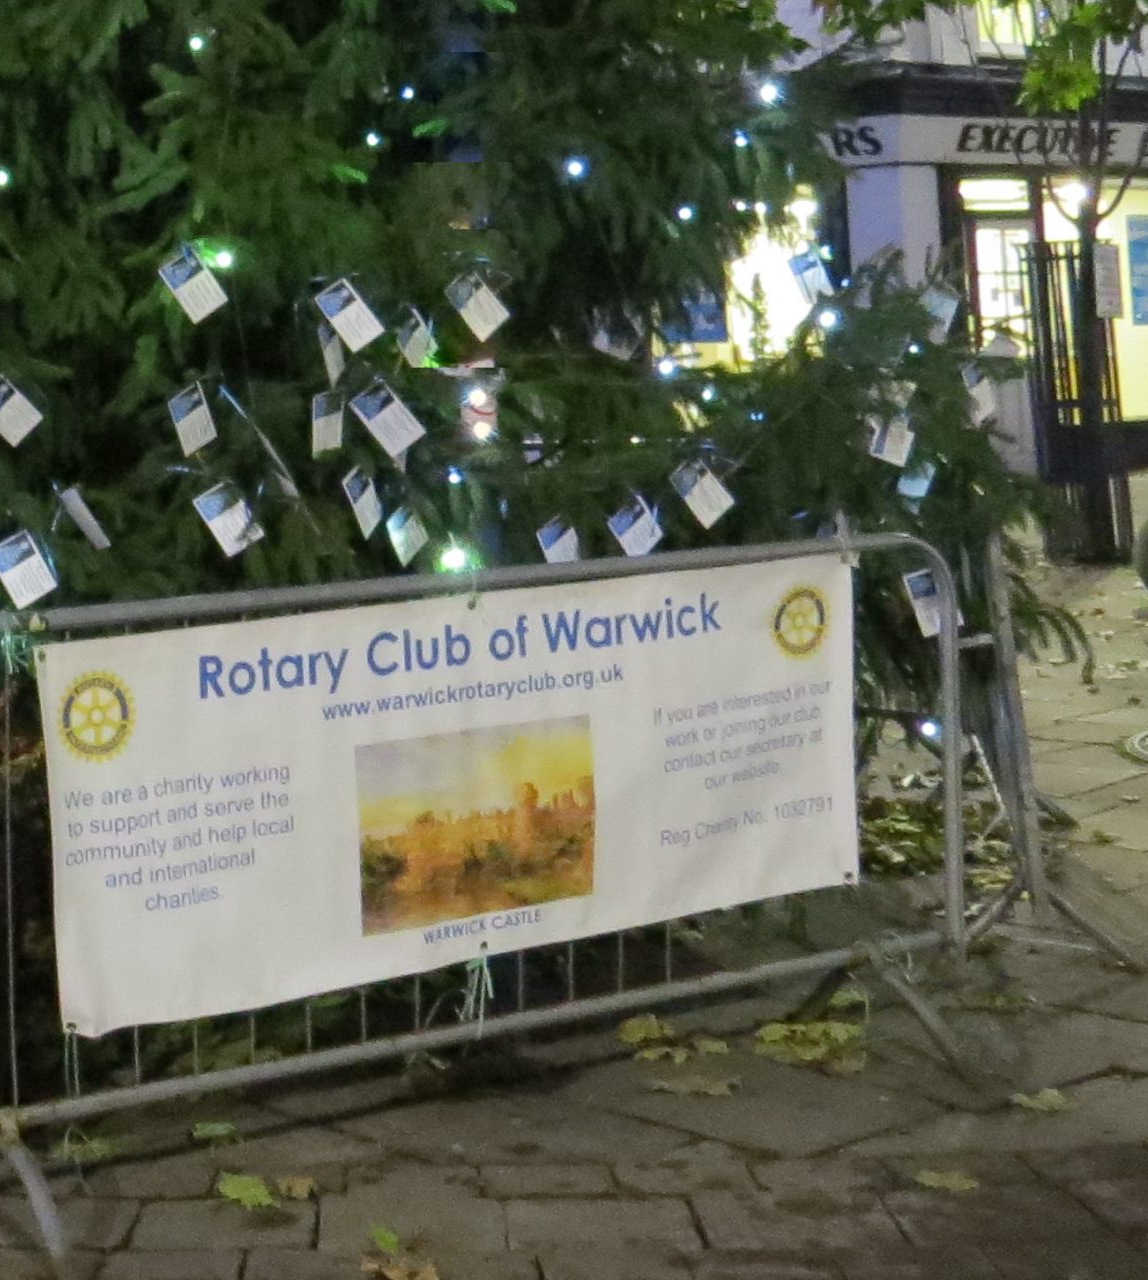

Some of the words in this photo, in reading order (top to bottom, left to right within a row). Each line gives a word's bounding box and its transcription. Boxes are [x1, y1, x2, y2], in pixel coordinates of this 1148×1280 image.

[198, 646, 349, 701] Rotary
[367, 624, 471, 677] Club
[489, 612, 529, 662] of
[541, 593, 720, 653] Warwick
[322, 663, 624, 721] www.warwickrotaryclub.org.uk
[667, 707, 694, 726] you
[697, 701, 719, 719] are
[722, 687, 791, 712] interested
[794, 685, 805, 700] in
[809, 680, 833, 697] our
[664, 749, 716, 774] contact
[720, 747, 742, 764] our
[745, 732, 805, 757] secretary
[665, 728, 698, 749] work
[703, 726, 717, 742] or
[721, 717, 766, 741] joining
[64, 790, 94, 810] We
[101, 787, 132, 807] are
[138, 785, 148, 801] a
[154, 772, 214, 797] charity
[220, 765, 290, 789] working
[68, 822, 83, 838] to
[90, 810, 160, 836] support
[167, 802, 197, 824] and
[204, 797, 254, 818] serve
[261, 791, 289, 810] the
[694, 817, 738, 840] Charity
[65, 837, 167, 868] community
[172, 828, 202, 851] and
[208, 823, 246, 845] help
[253, 815, 294, 838] local
[105, 867, 142, 889] and
[150, 848, 255, 883] international
[423, 921, 486, 945] WARWICK
[491, 908, 542, 930] CASTLE
